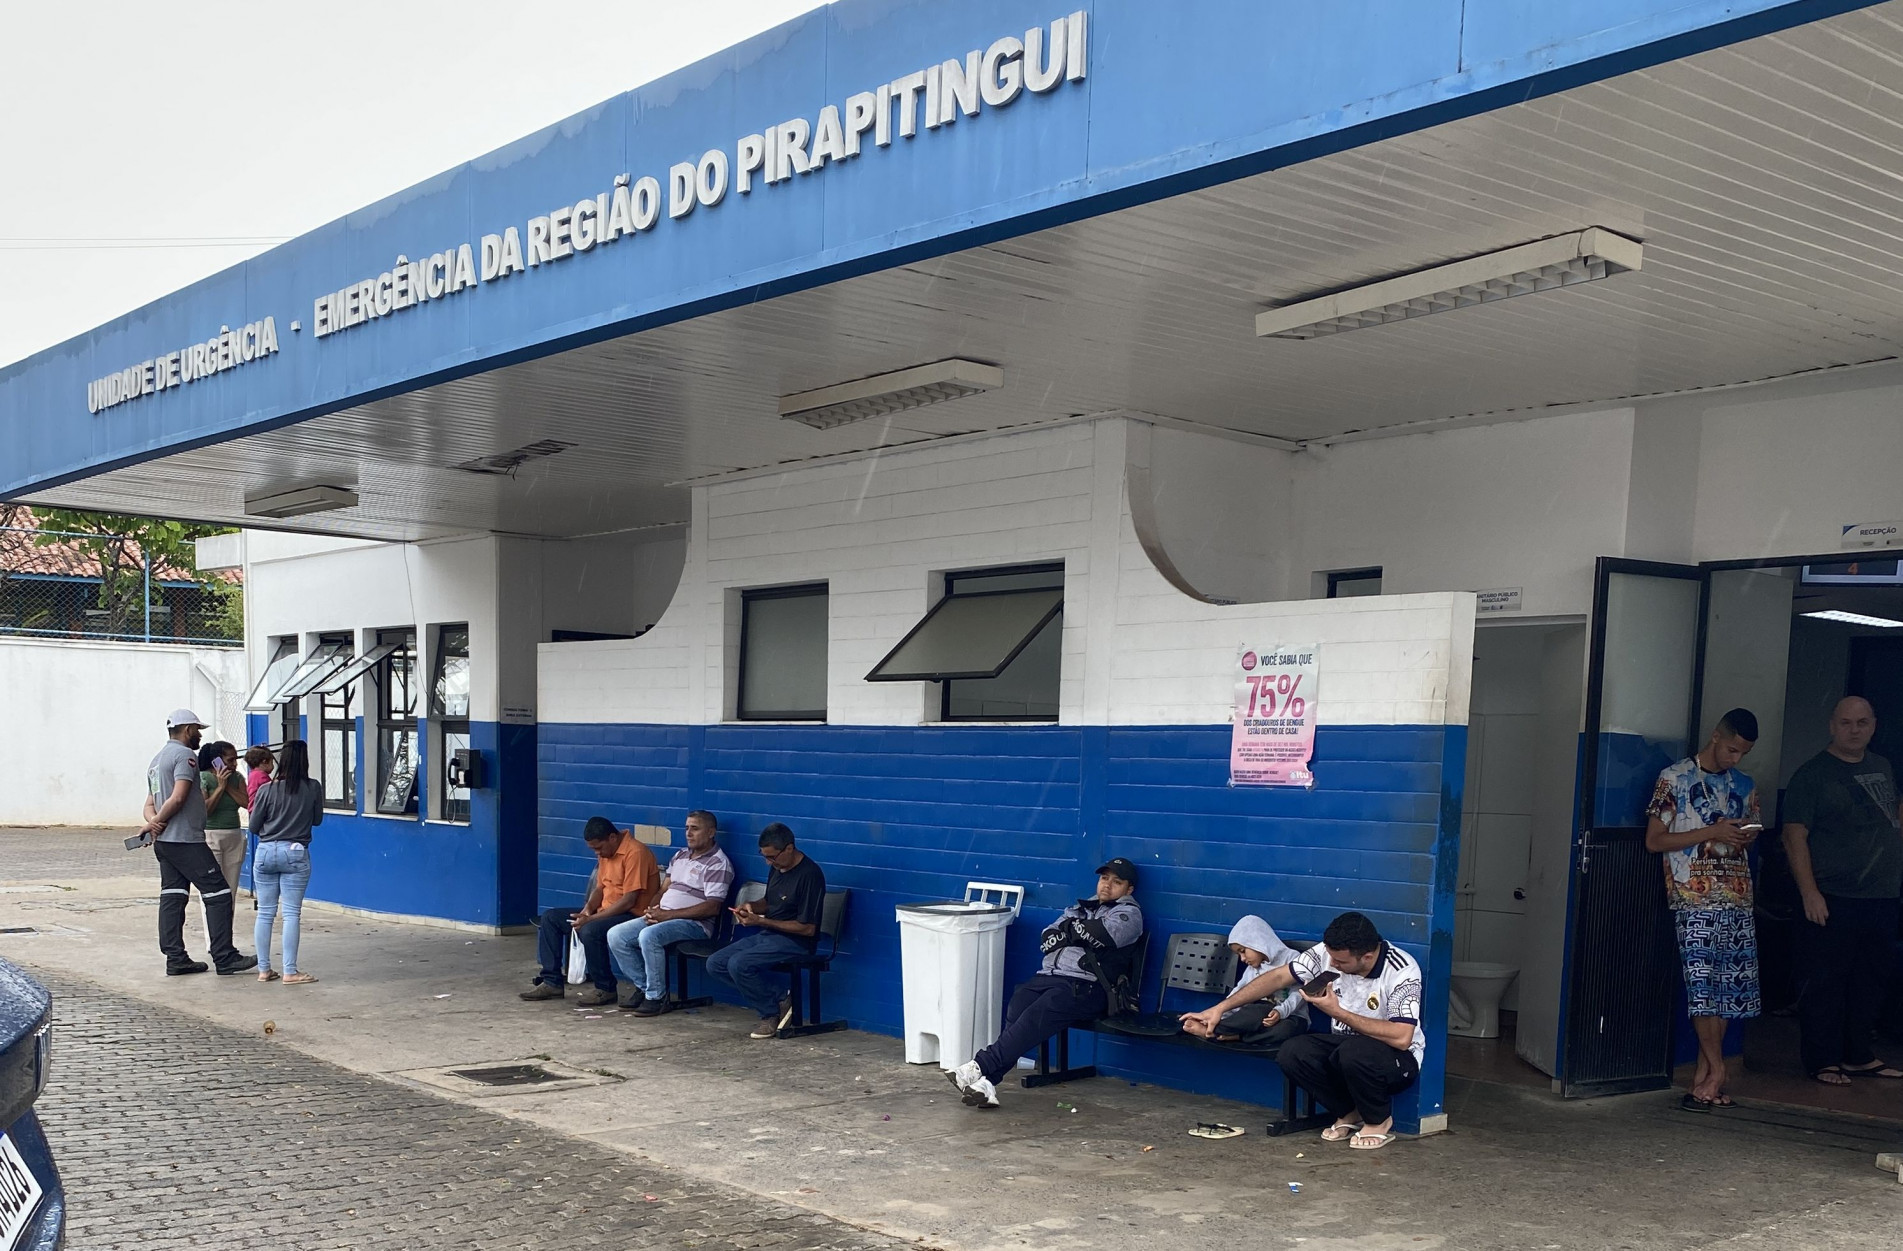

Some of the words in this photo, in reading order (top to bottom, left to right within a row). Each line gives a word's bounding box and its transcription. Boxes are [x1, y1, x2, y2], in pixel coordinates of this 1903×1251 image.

[87, 359, 154, 414] UNIDADE
[155, 351, 180, 391] DE
[181, 316, 279, 384] URGÊNCIA
[314, 254, 478, 338] EMERGÊNCIA
[481, 226, 525, 282] DA
[528, 172, 661, 267] REGIÃO
[669, 149, 729, 219] DO
[736, 10, 1088, 194] PIRAPITINGUI
[1859, 526, 1897, 536] RECEPÇÃO
[1261, 653, 1277, 666] VOCÊ
[1279, 654, 1297, 666] SABIA
[1299, 654, 1312, 666] QUE
[1246, 674, 1305, 718] 75%
[1279, 719, 1286, 727] DE
[1278, 727, 1285, 735] DE
